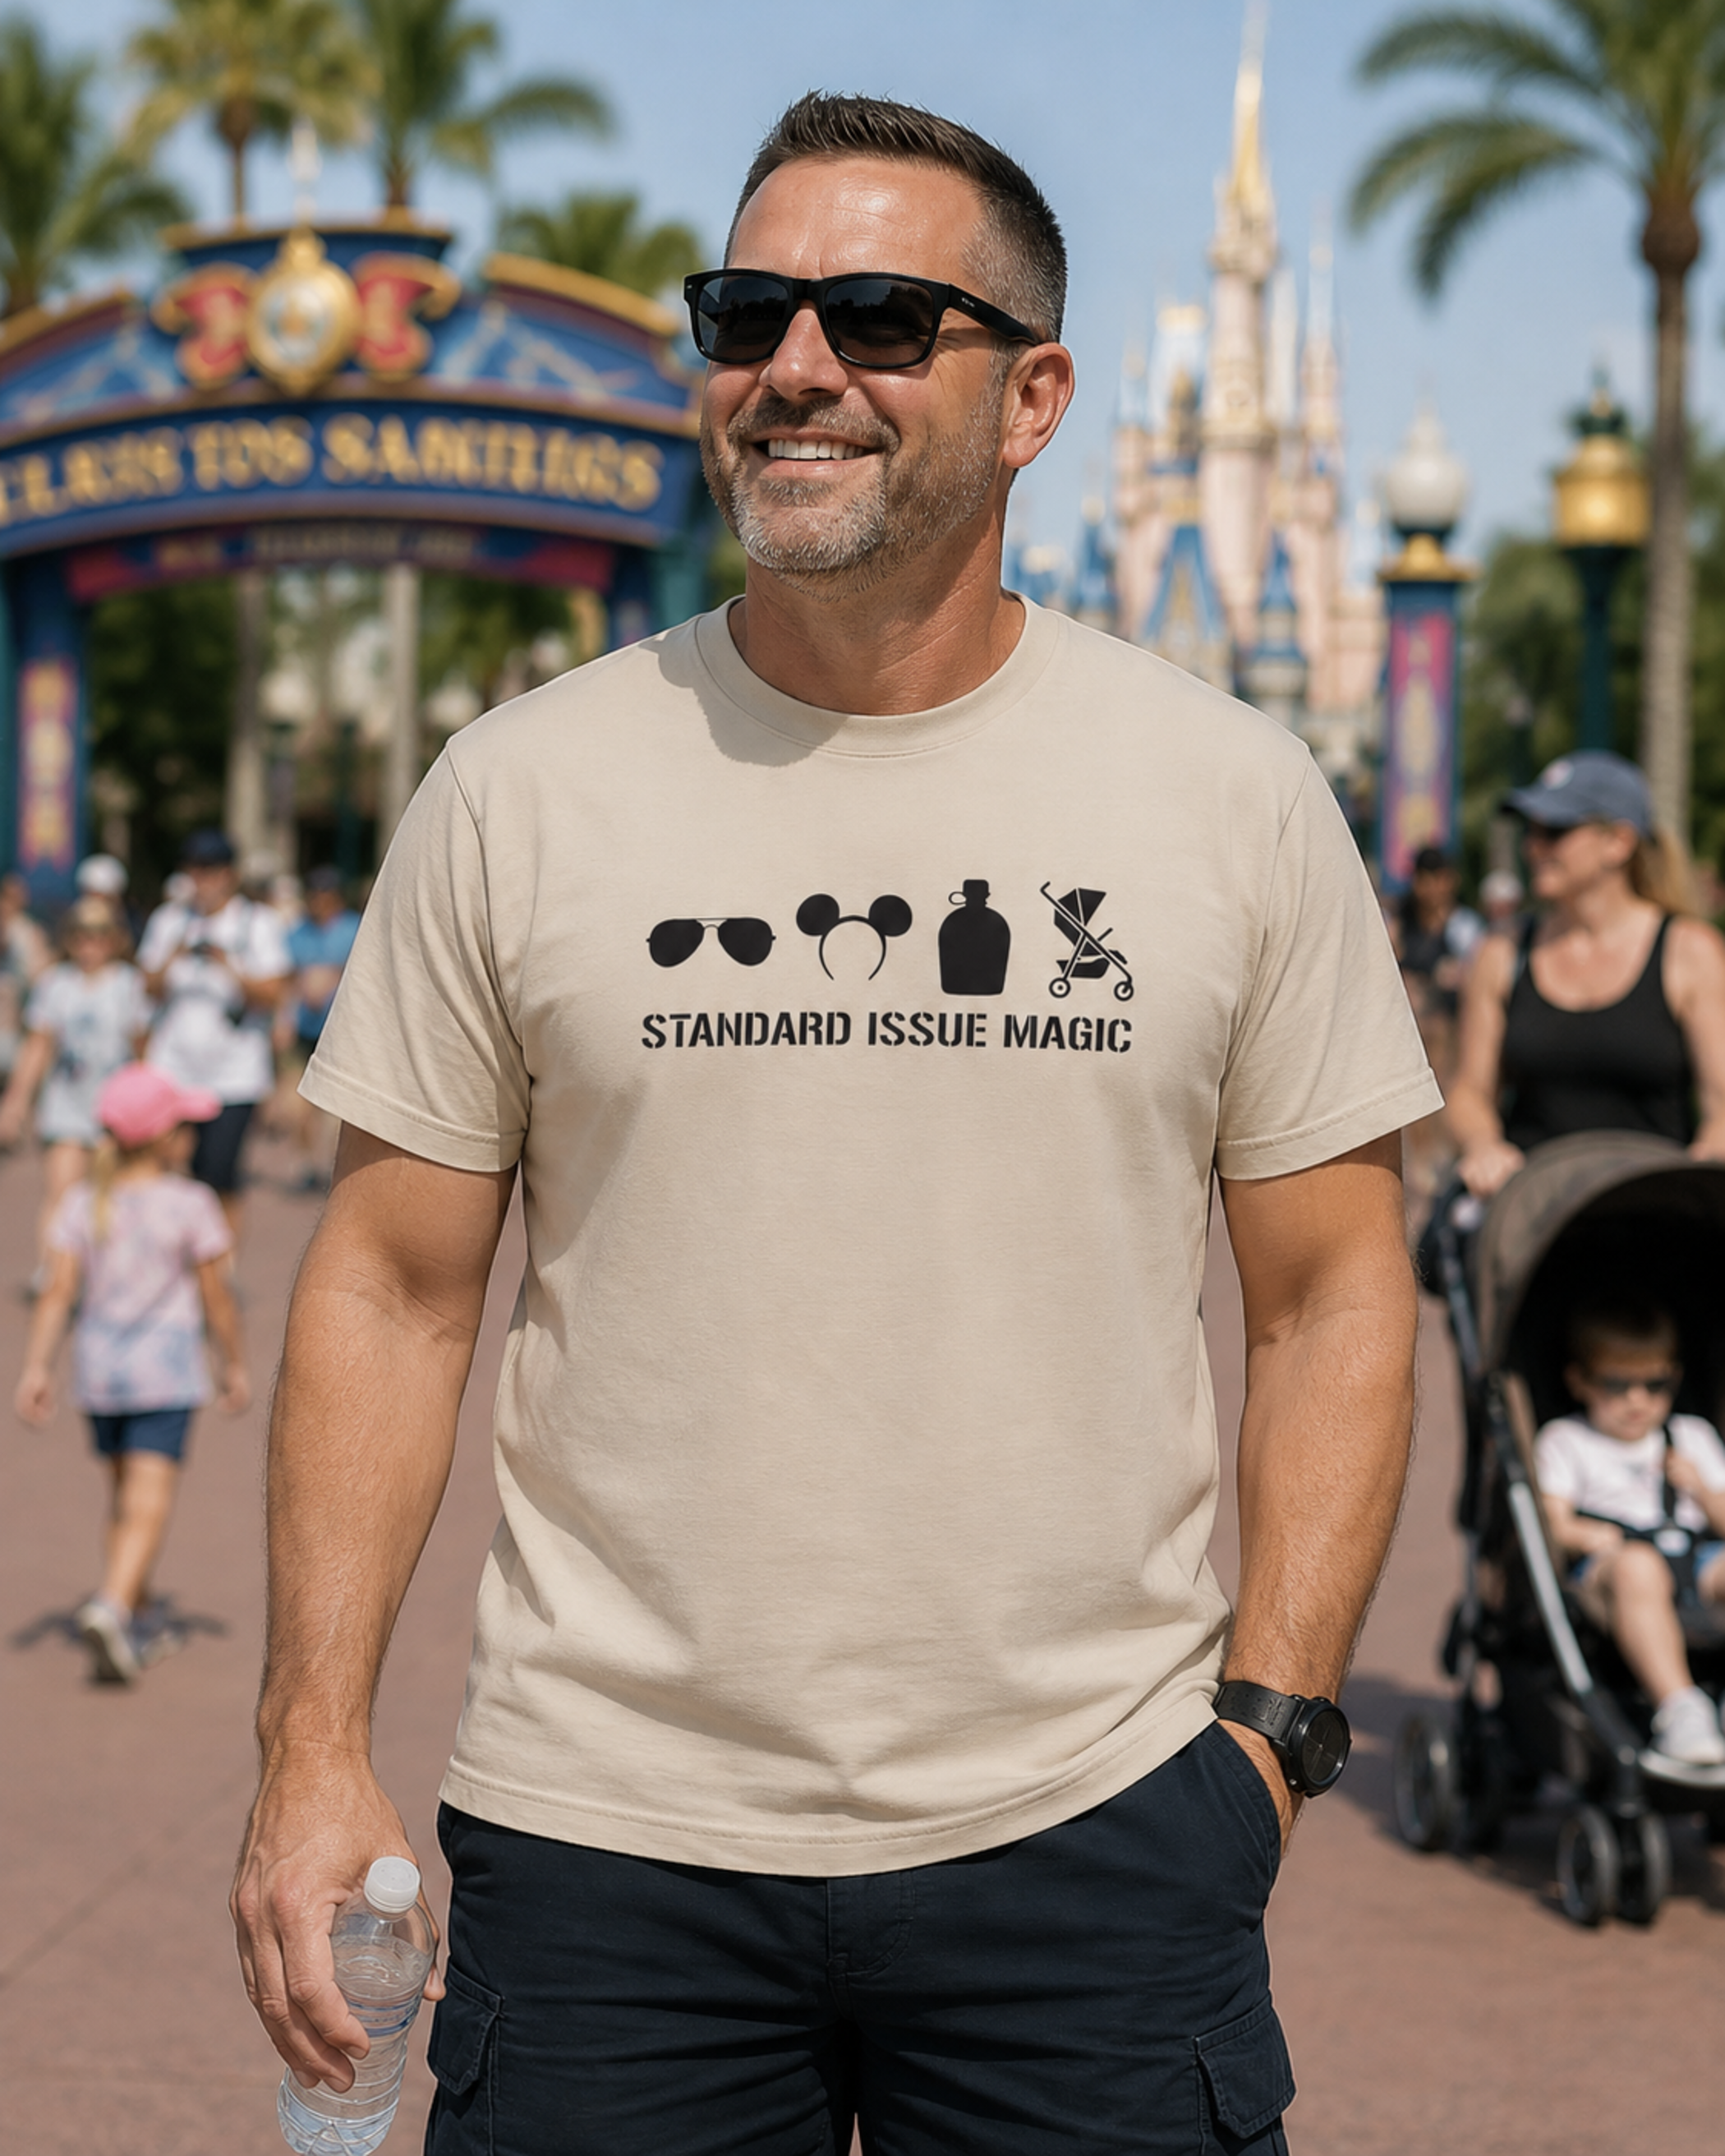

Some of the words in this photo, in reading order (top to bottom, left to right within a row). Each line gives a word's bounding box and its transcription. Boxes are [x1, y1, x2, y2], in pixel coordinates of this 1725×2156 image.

[642, 1011, 851, 1048] STANDARD
[867, 1011, 987, 1047] ISSUE
[1003, 1014, 1132, 1053] MAGIC
